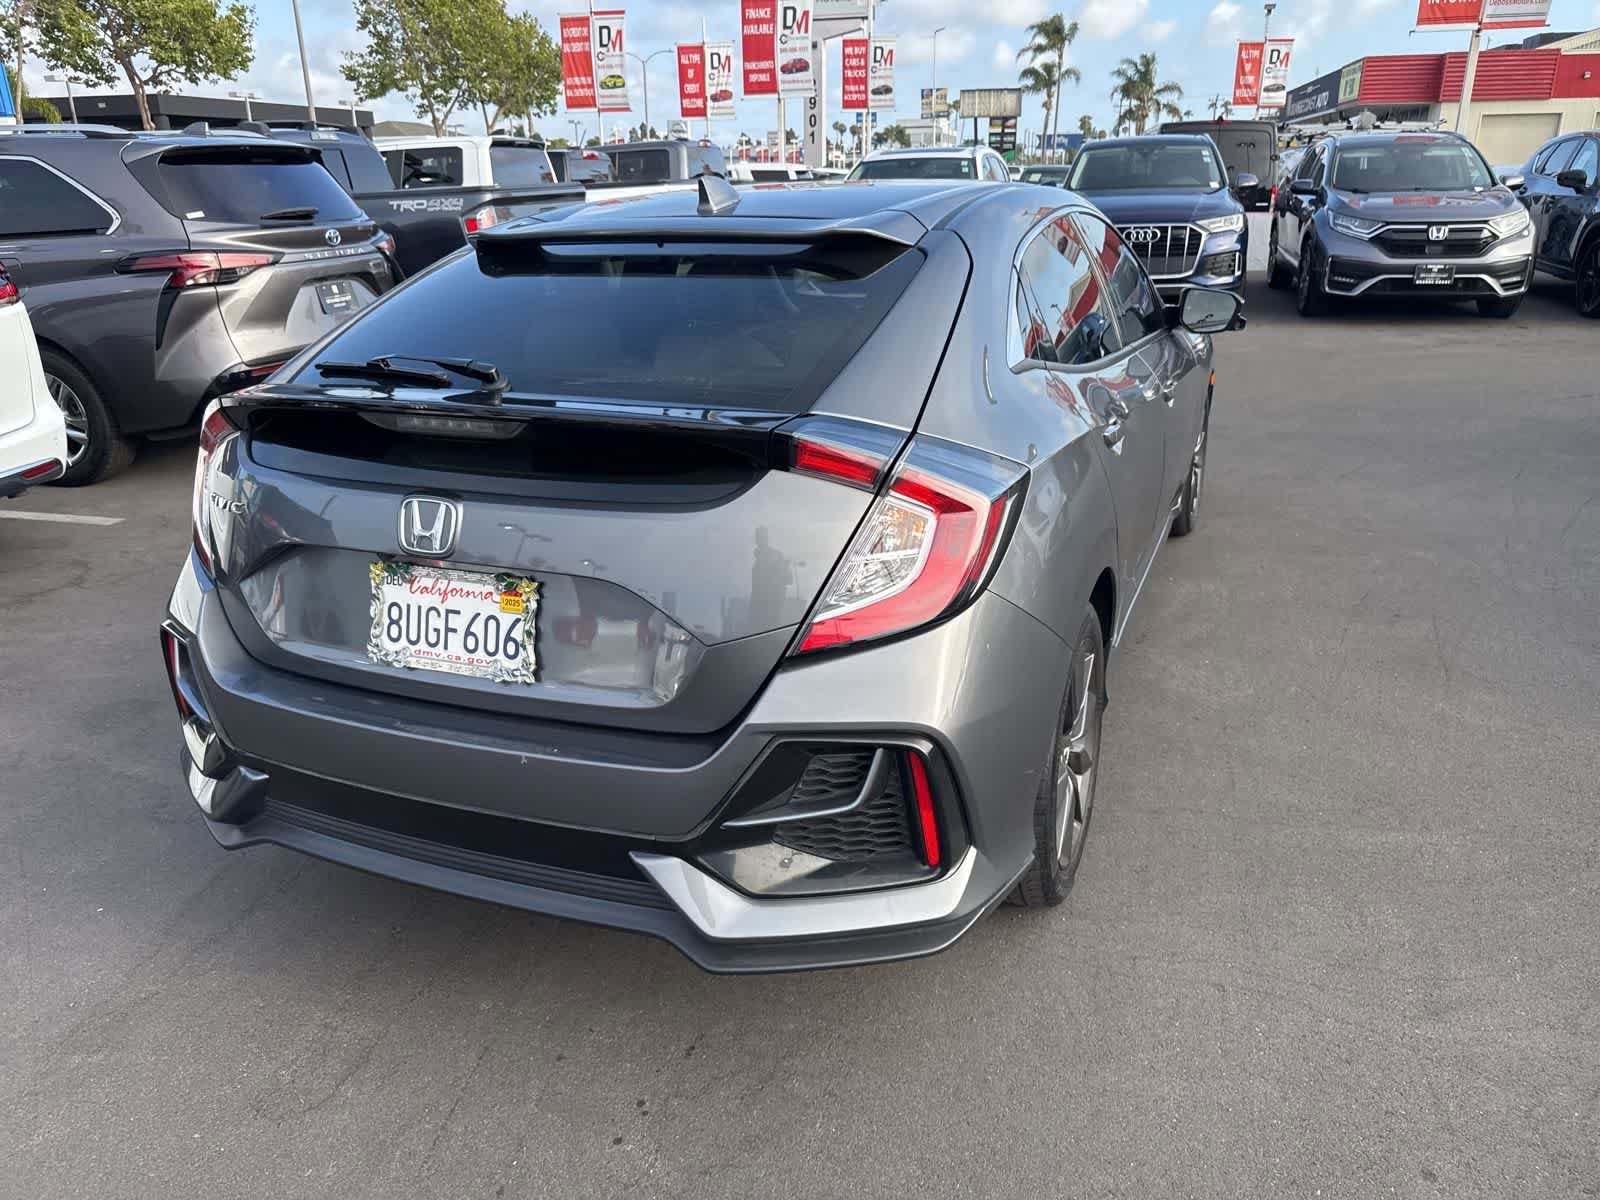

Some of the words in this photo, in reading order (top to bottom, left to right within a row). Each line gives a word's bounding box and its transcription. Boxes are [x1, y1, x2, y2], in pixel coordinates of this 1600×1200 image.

[745, 8, 771, 19] FINANCE
[743, 24, 774, 35] AVAILABLE
[409, 576, 502, 604] California
[387, 601, 522, 661] 8UGF606
[413, 648, 493, 666] dmv.ca.gov
